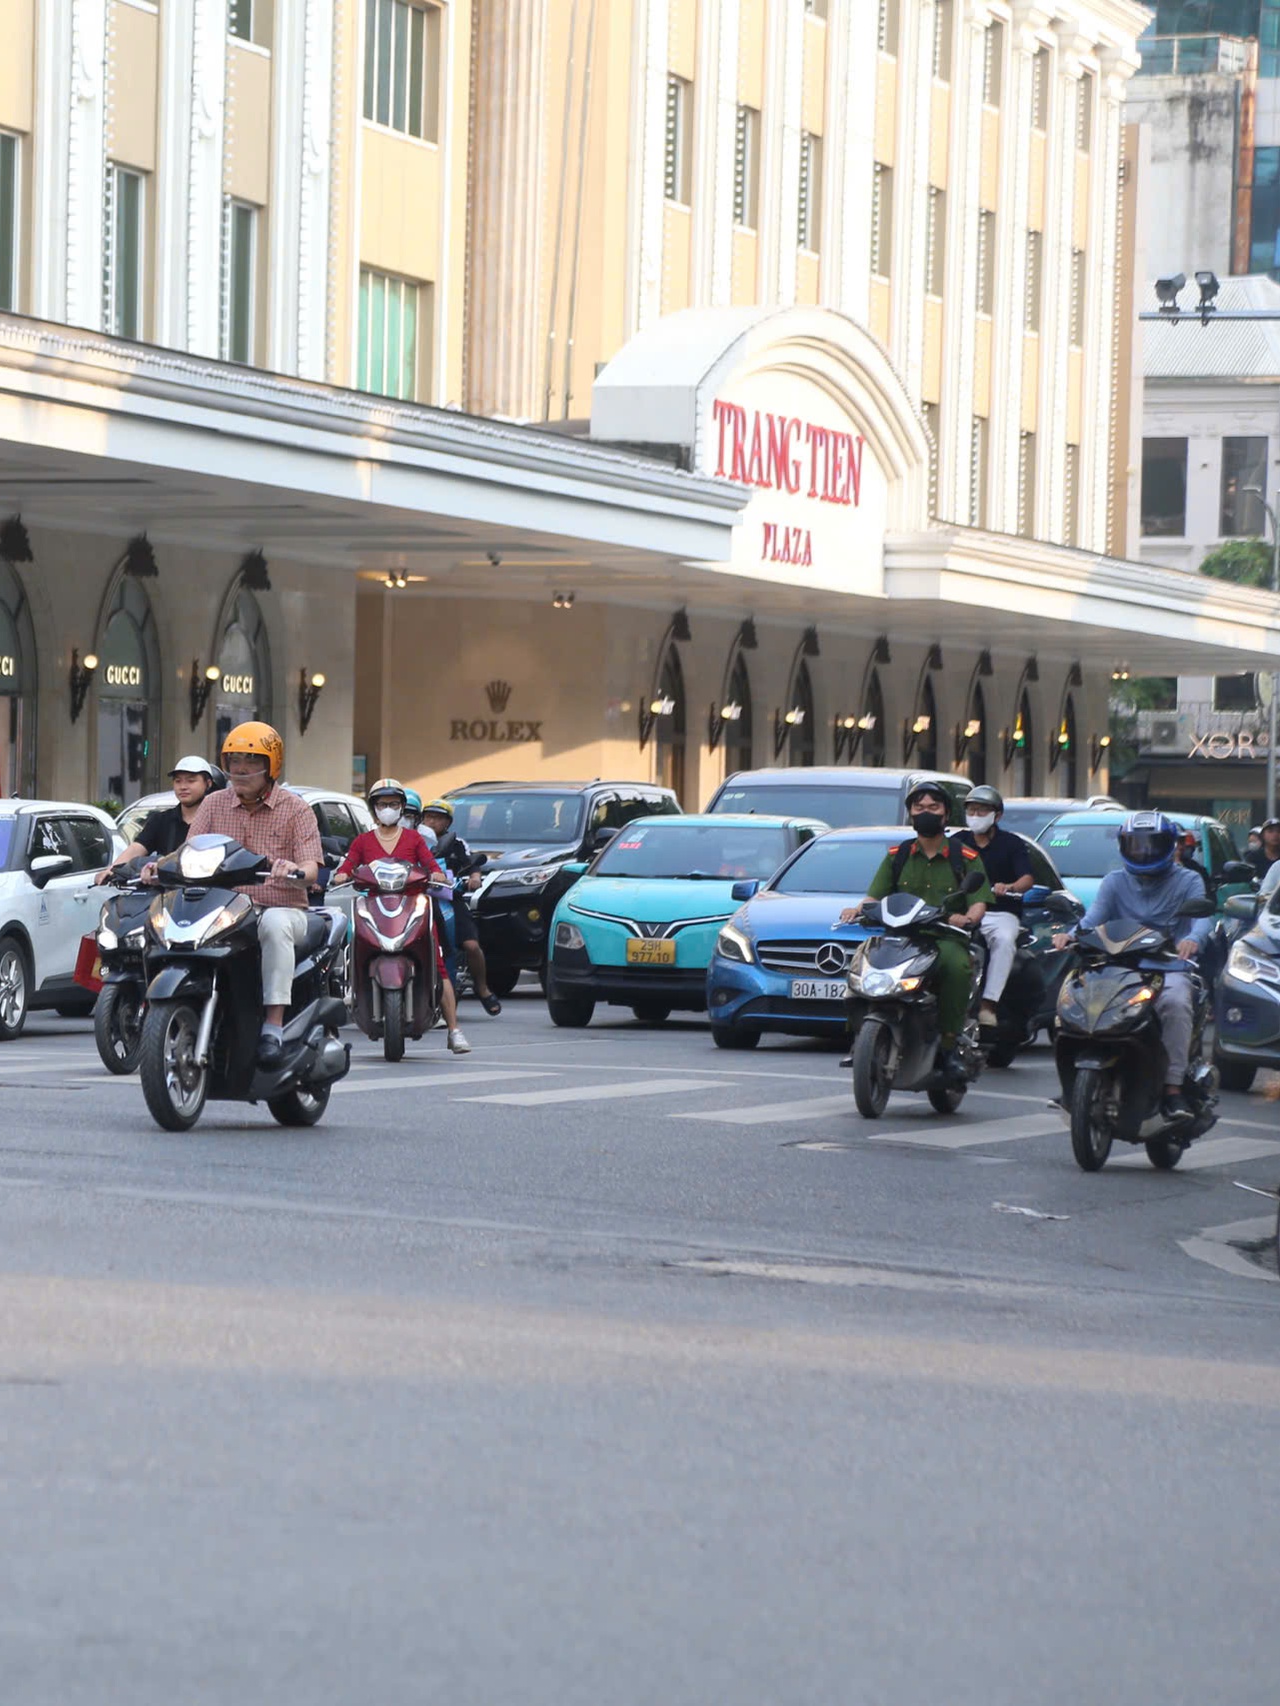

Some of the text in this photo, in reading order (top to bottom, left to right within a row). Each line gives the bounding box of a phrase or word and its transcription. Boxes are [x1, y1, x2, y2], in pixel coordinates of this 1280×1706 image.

[713, 398, 866, 508] TRANG TIEN
[761, 522, 813, 568] PLAZA
[106, 664, 141, 686] GUCCI
[222, 674, 254, 694] GUCCI
[450, 719, 544, 742] ROLEX
